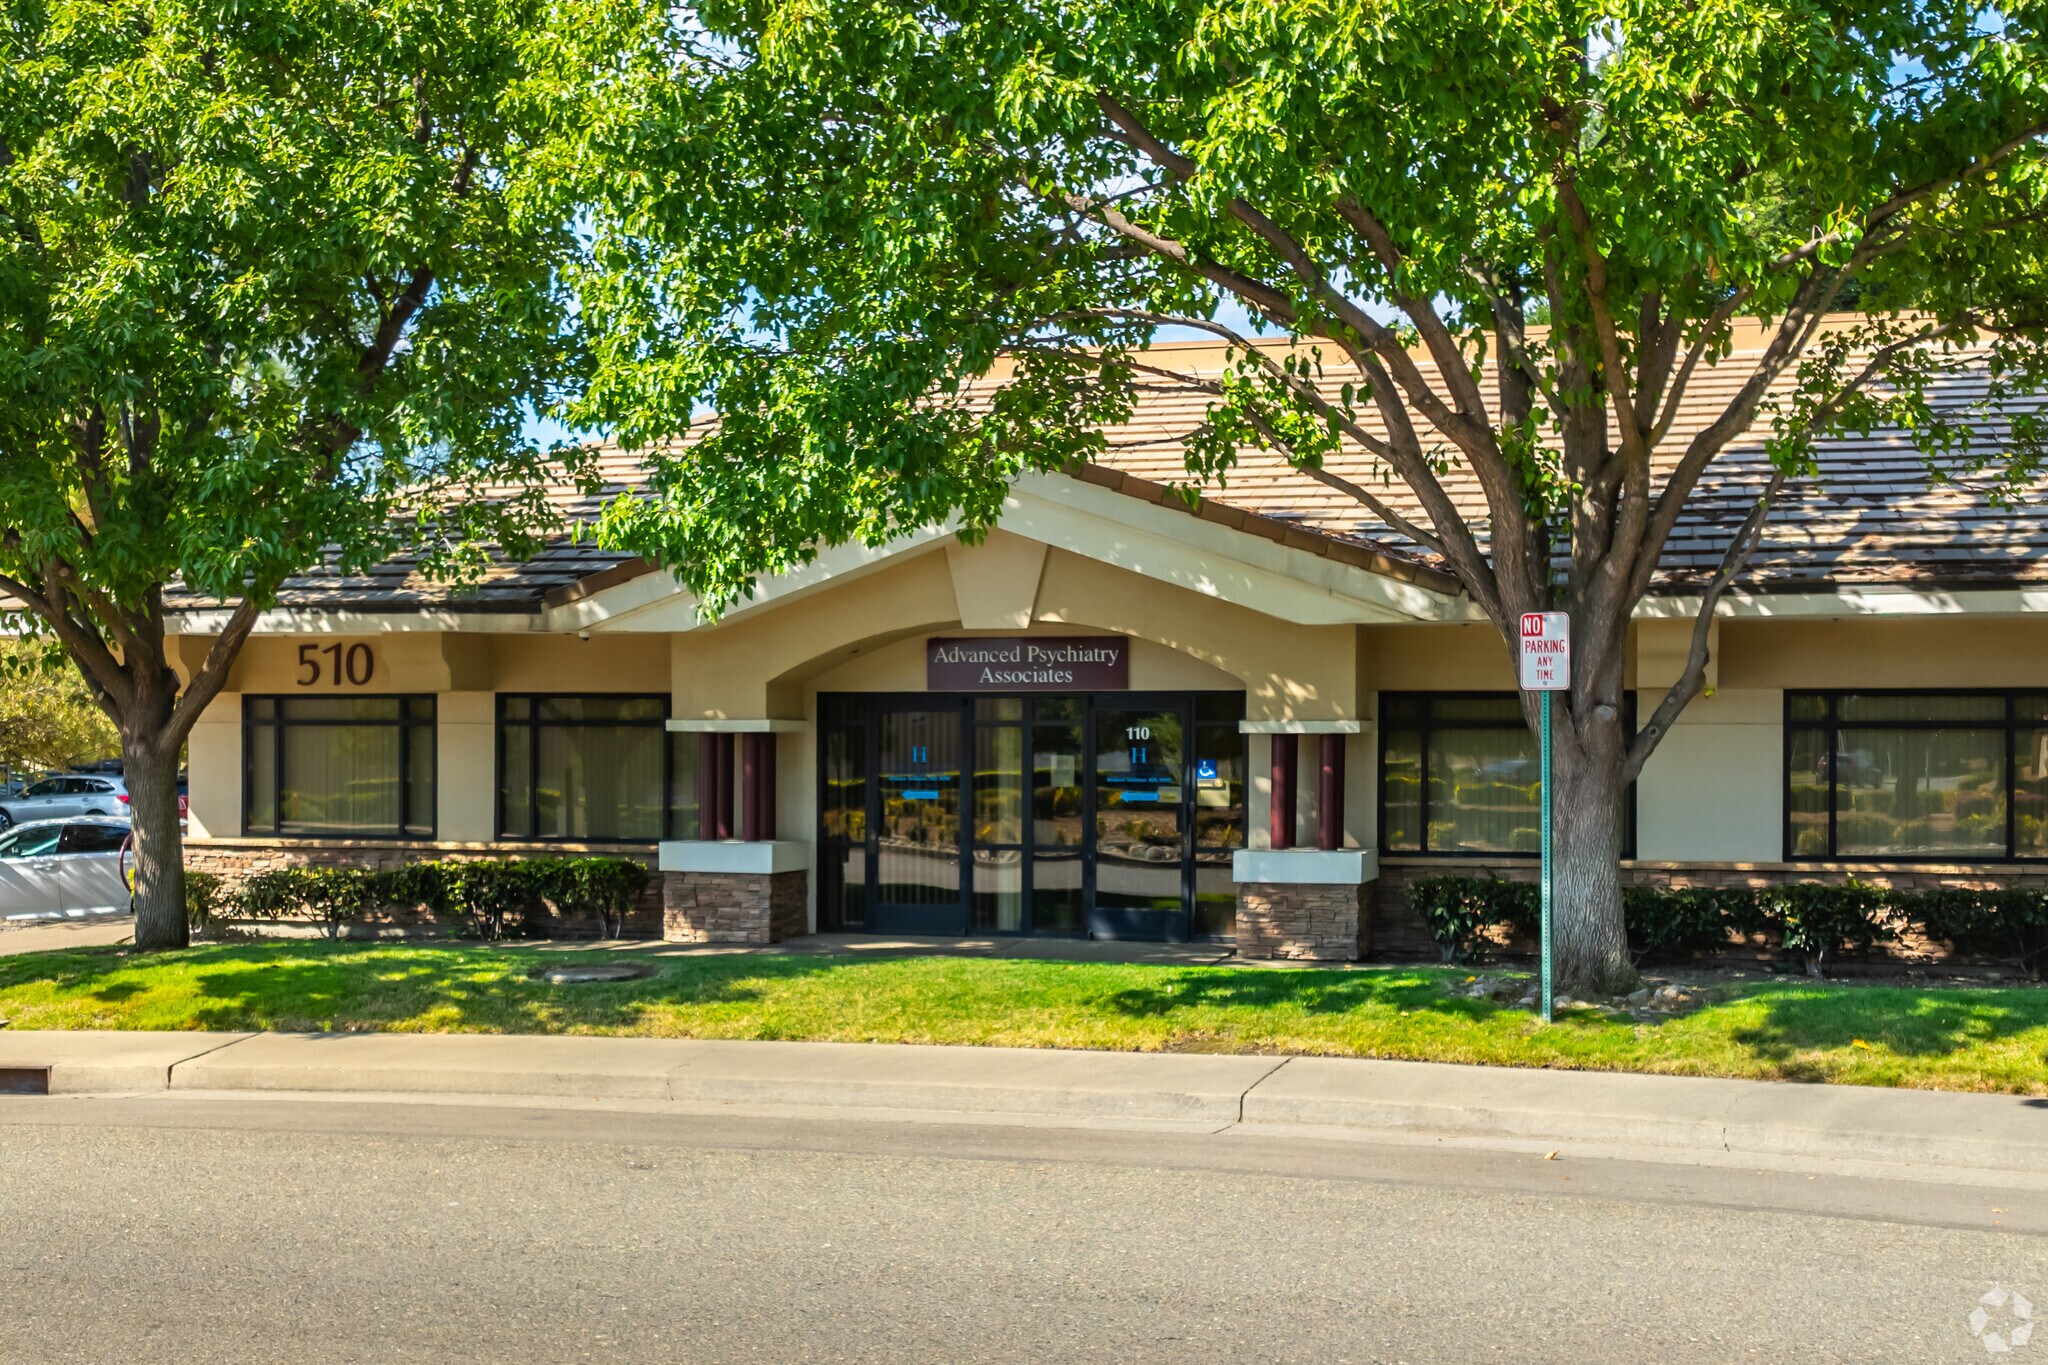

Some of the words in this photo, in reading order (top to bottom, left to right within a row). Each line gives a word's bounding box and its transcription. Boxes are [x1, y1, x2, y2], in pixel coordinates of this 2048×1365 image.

[1523, 616, 1540, 633] NO
[1525, 639, 1565, 653] PARKING
[934, 646, 1021, 663] Advanced
[1027, 645, 1119, 667] Psychiatry
[1537, 656, 1553, 667] ANY
[297, 642, 374, 686] 510
[979, 666, 1073, 683] Associates
[1536, 669, 1554, 681] TIME
[1126, 727, 1150, 740] 110
